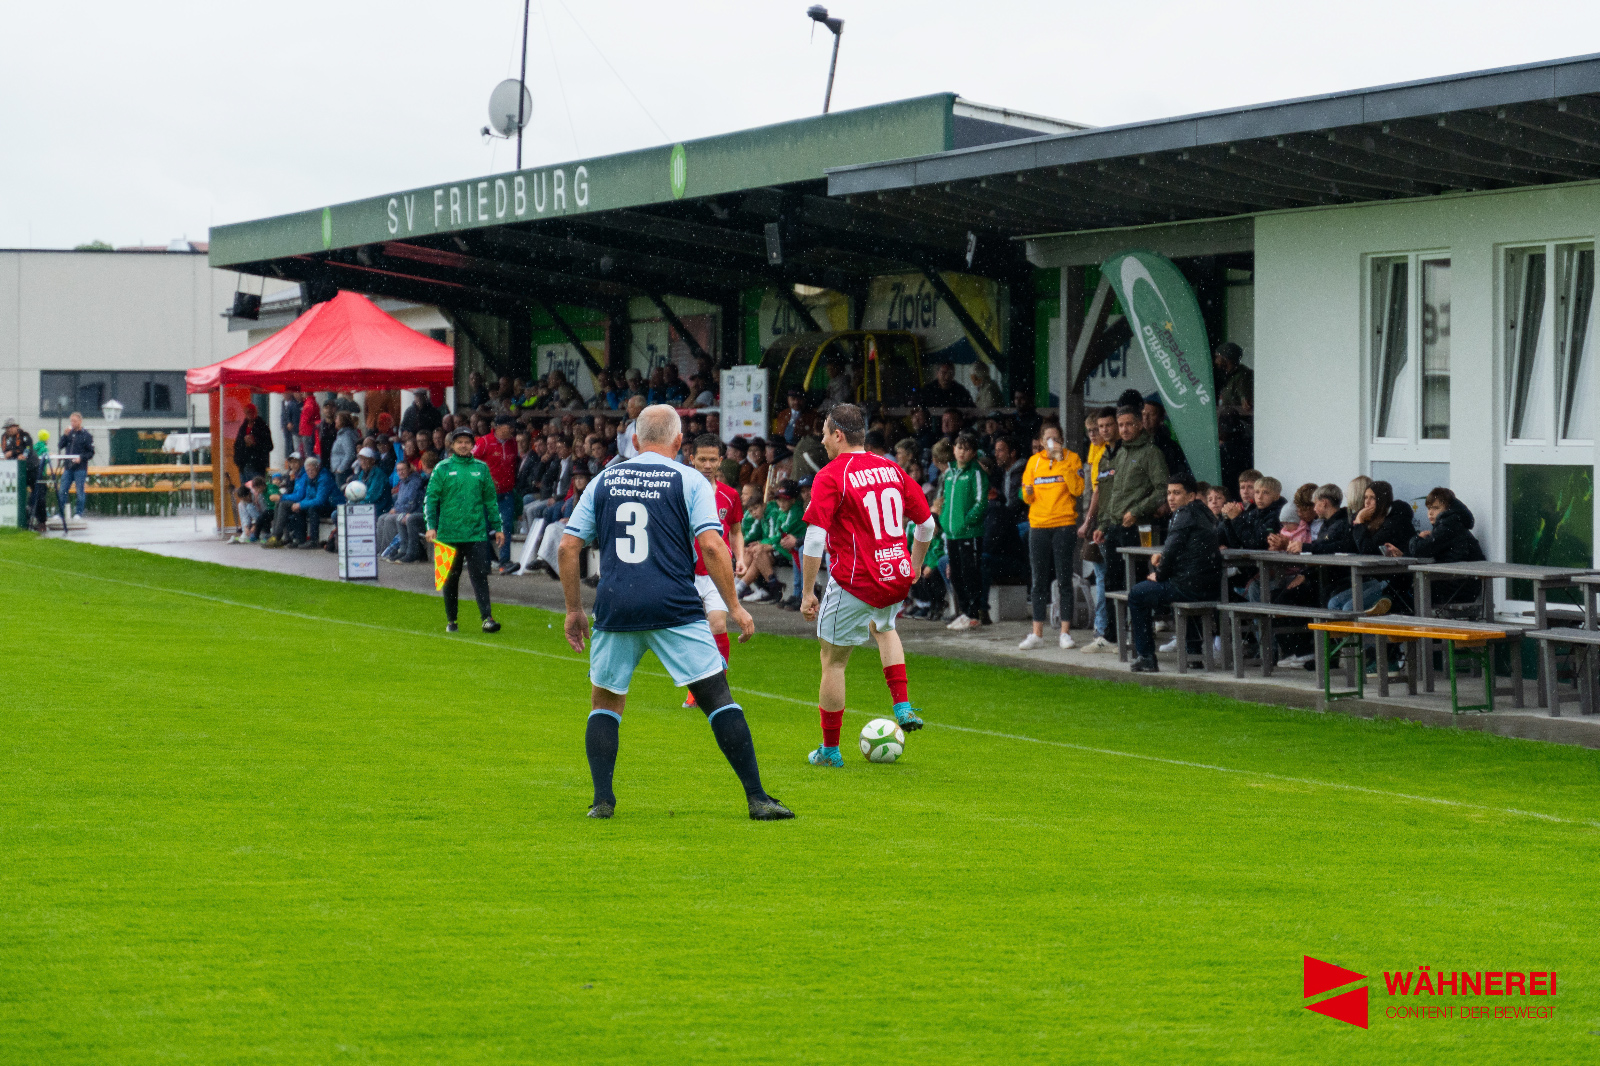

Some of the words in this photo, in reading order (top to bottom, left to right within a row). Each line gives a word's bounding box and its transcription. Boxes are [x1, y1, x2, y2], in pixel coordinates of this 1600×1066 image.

[387, 195, 417, 234] SV
[434, 165, 589, 227] FRIEDBURG
[888, 279, 939, 331] Zipfer
[603, 477, 671, 488] Fußball-Team
[610, 486, 661, 499] Österreich
[615, 502, 649, 564] 3
[863, 487, 904, 540] 10
